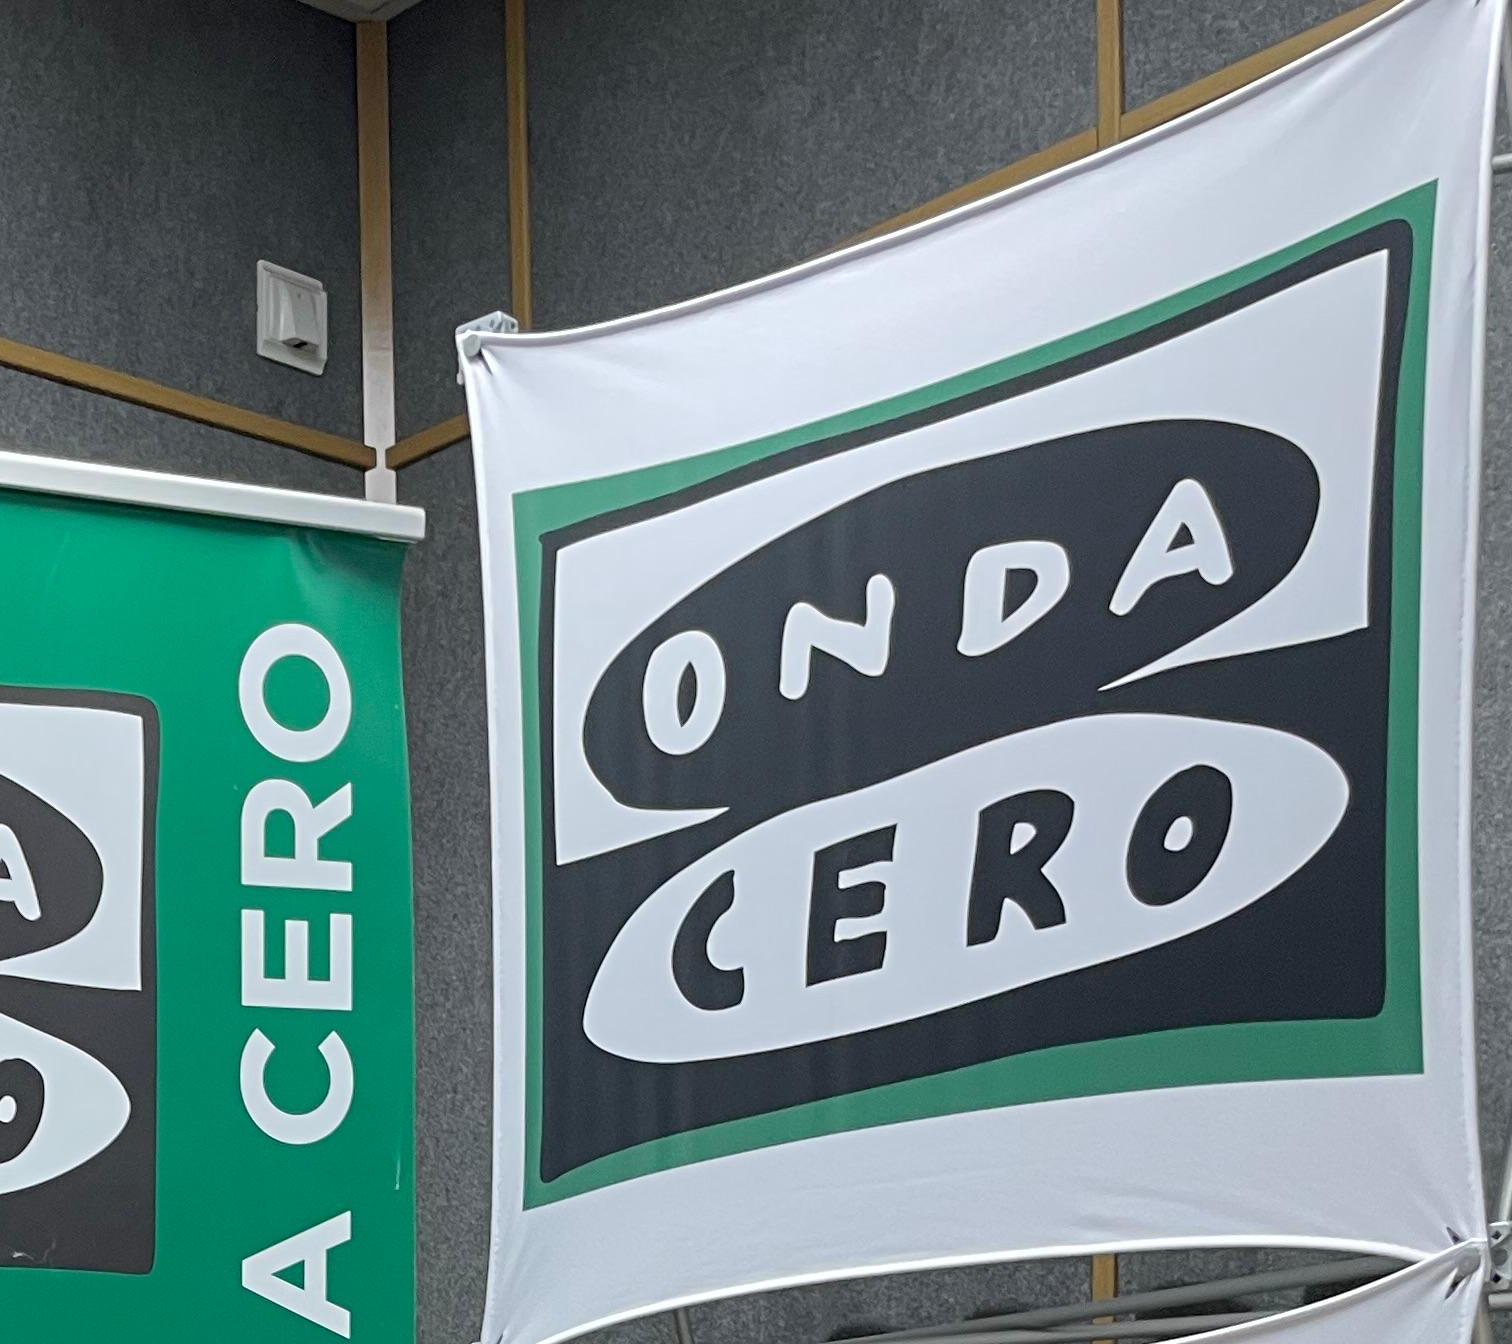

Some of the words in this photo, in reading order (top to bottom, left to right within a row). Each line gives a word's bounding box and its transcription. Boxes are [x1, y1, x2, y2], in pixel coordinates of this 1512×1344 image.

[642, 478, 1234, 755] ONDA
[238, 623, 354, 1145] CERO
[671, 763, 1234, 1011] CERO
